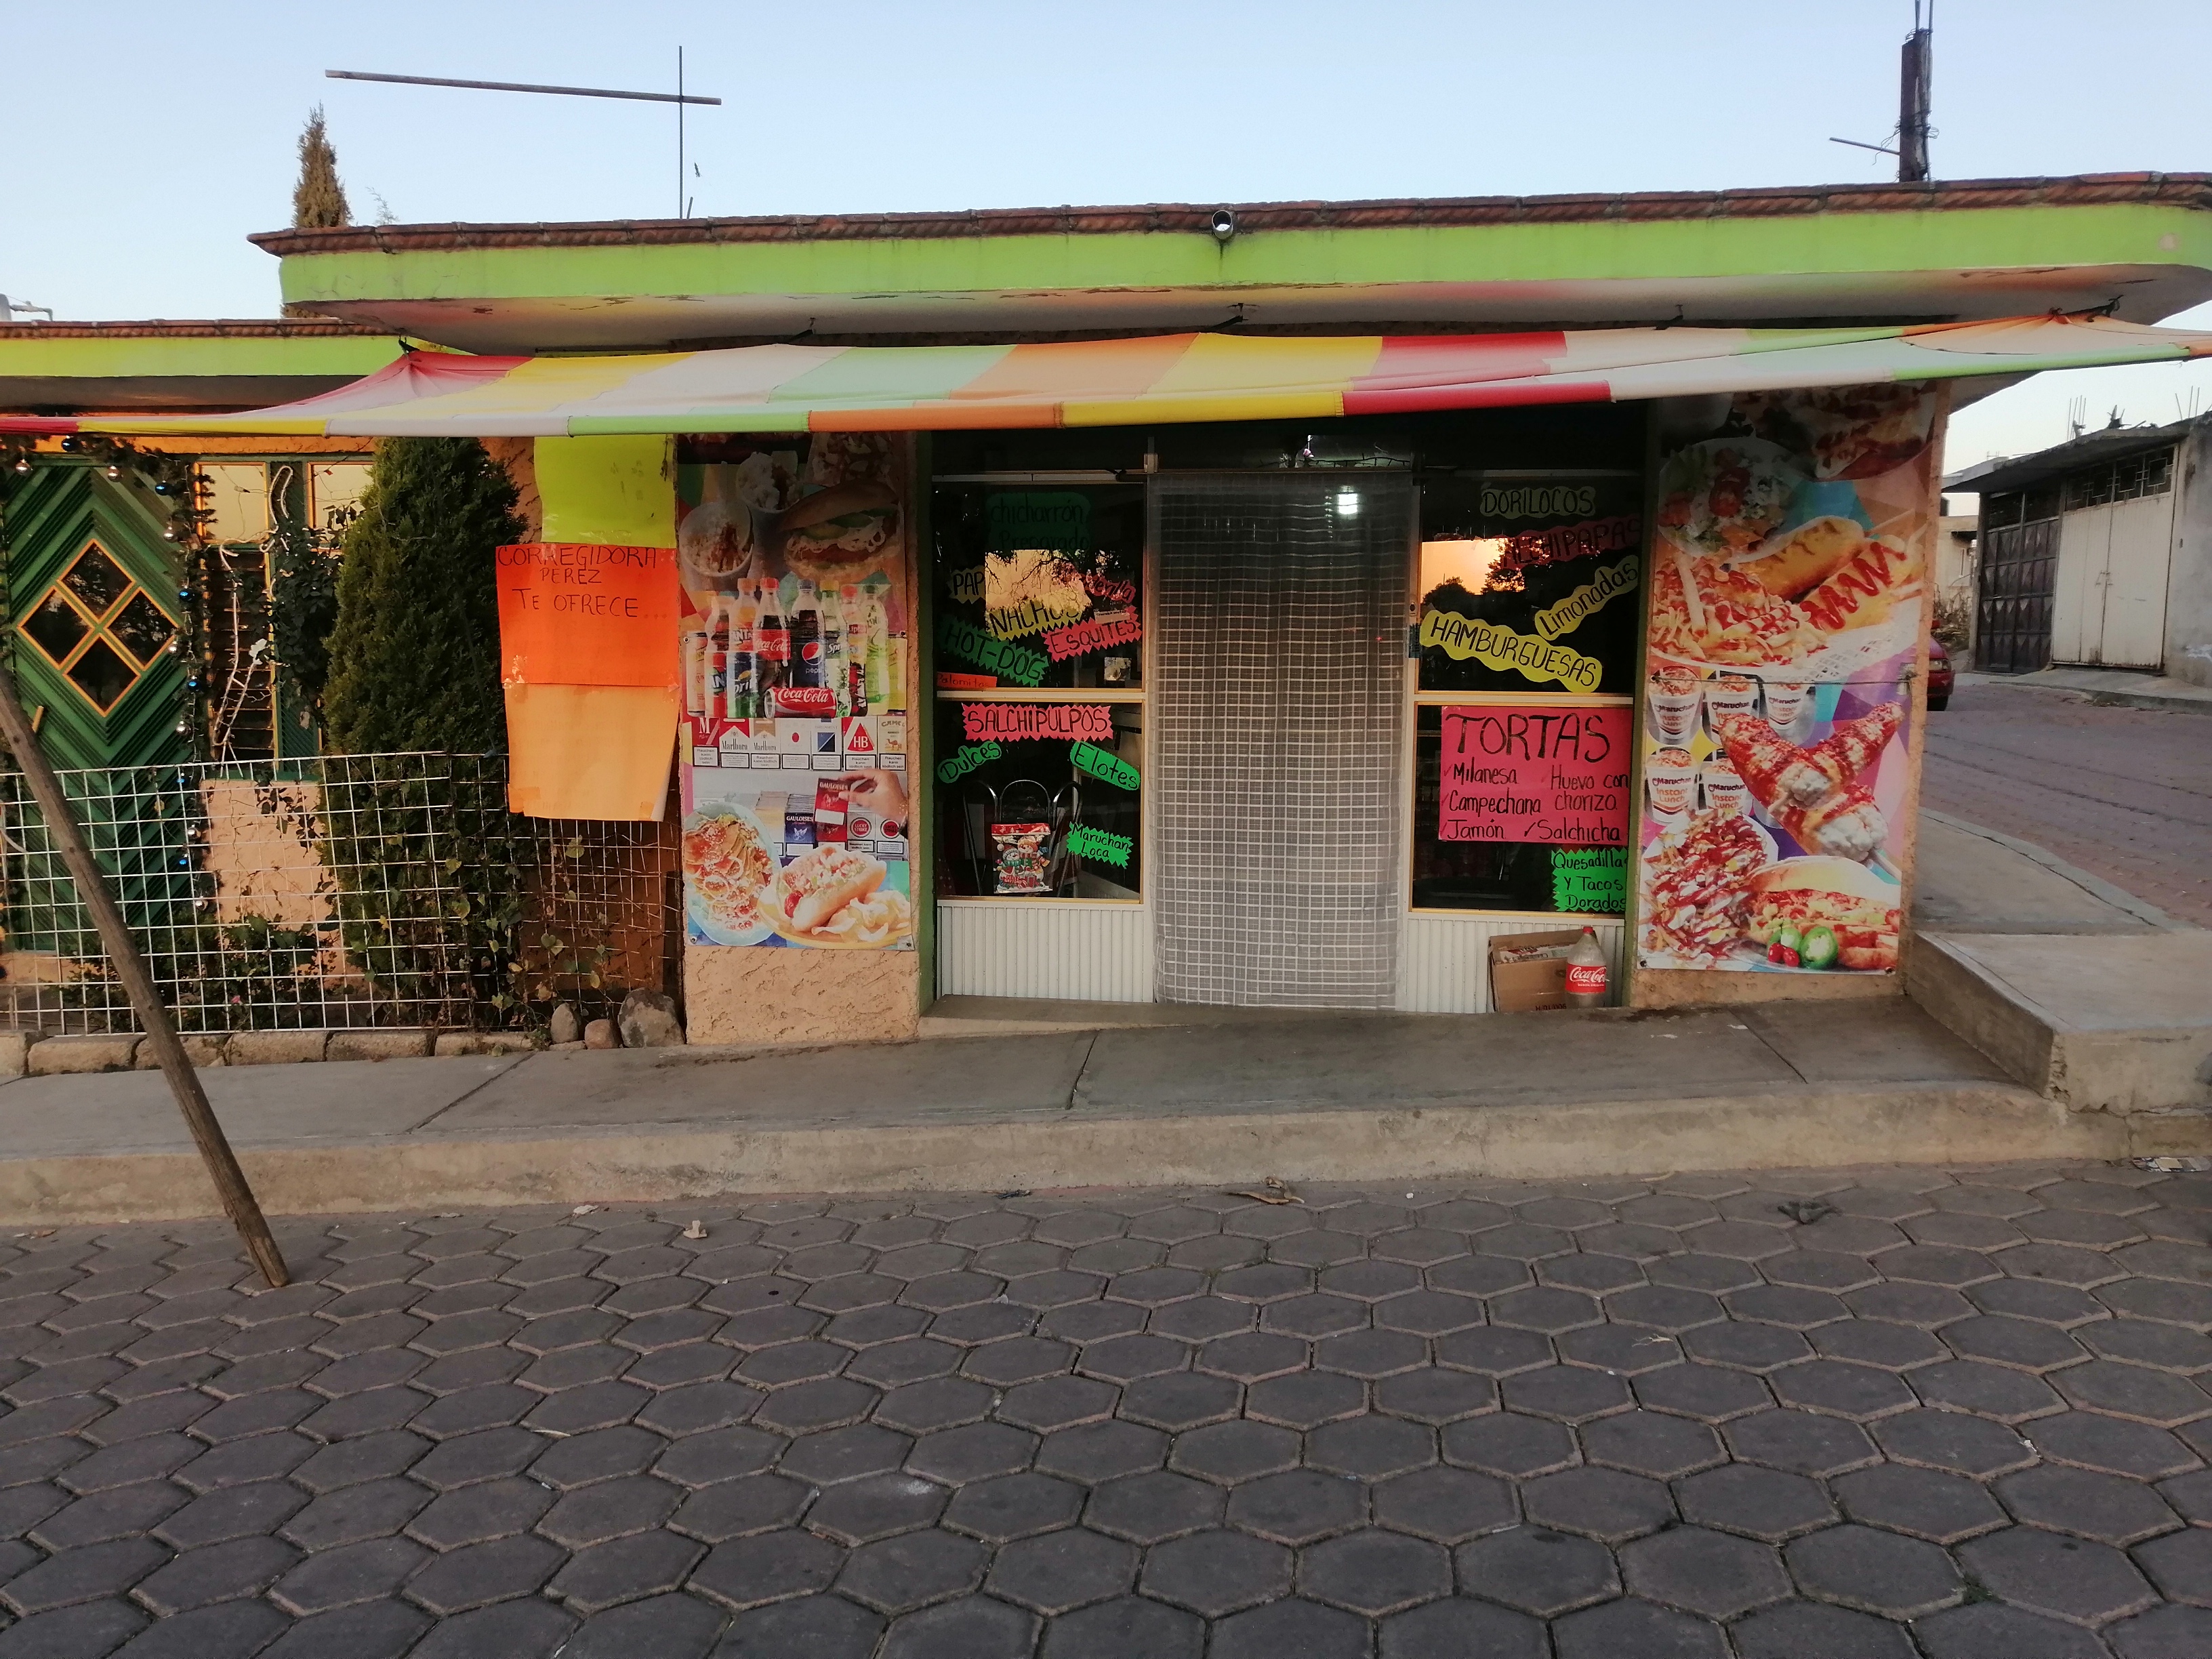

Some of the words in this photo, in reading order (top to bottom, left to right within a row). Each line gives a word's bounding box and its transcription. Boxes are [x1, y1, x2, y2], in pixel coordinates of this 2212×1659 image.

[1483, 488, 1593, 514] DORILOCOS
[1500, 518, 1640, 567] ALCHIPAPAS
[497, 545, 657, 571] CORREGIDORA
[539, 567, 602, 585] PEREZ
[1538, 562, 1638, 636] Limonadas
[1050, 619, 1136, 654] ESQUITES
[1430, 615, 1596, 687] HAMBURGUESAS
[967, 708, 1109, 733] SALCHIPULPOS
[722, 738, 748, 750] Marlboro
[754, 740, 777, 751] Marlboro
[853, 735, 869, 748] HB
[1445, 713, 1611, 763] TORTAS
[939, 741, 1002, 780] Dulces
[1074, 742, 1139, 790] Elotes
[1453, 756, 1518, 785] Milanesa
[1551, 764, 1595, 790] Huevo
[1603, 773, 1629, 789] con
[1448, 787, 1542, 818] Campechana
[1071, 823, 1130, 852] Maruchan
[1447, 818, 1504, 840] Jamón
[1537, 817, 1621, 842] Salchicha
[1081, 840, 1110, 859] Loca
[1576, 876, 1624, 892] Tacos
[1565, 893, 1626, 909] Dorados
